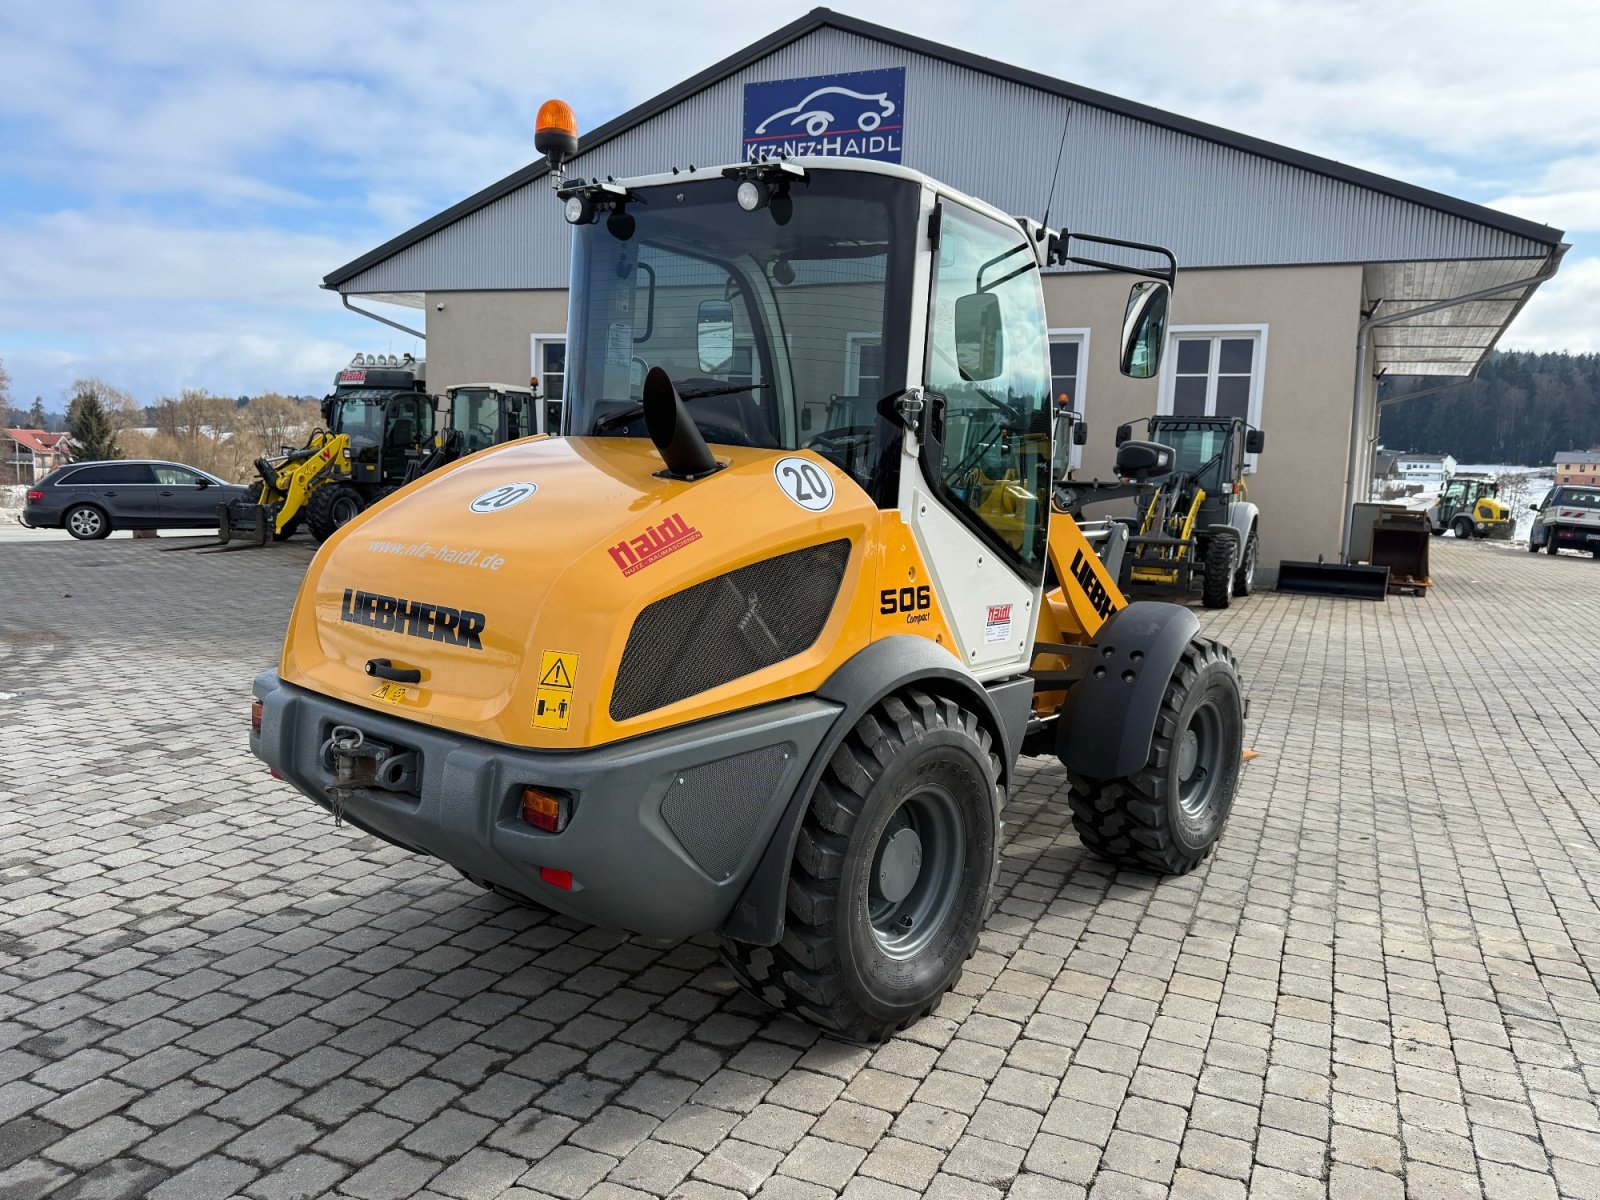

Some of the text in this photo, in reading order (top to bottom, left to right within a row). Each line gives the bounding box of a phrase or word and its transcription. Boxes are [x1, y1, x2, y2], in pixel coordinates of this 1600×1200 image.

[475, 487, 529, 507] 20
[783, 464, 827, 501] 20
[368, 541, 505, 570] www.nfz-haidl.de
[607, 513, 696, 570] Haidl
[624, 561, 645, 576] NUTZ
[648, 533, 701, 563] BAUMASCHINEN
[880, 586, 930, 615] 506
[341, 588, 486, 650] LIEBHERR
[906, 612, 930, 624] Compact
